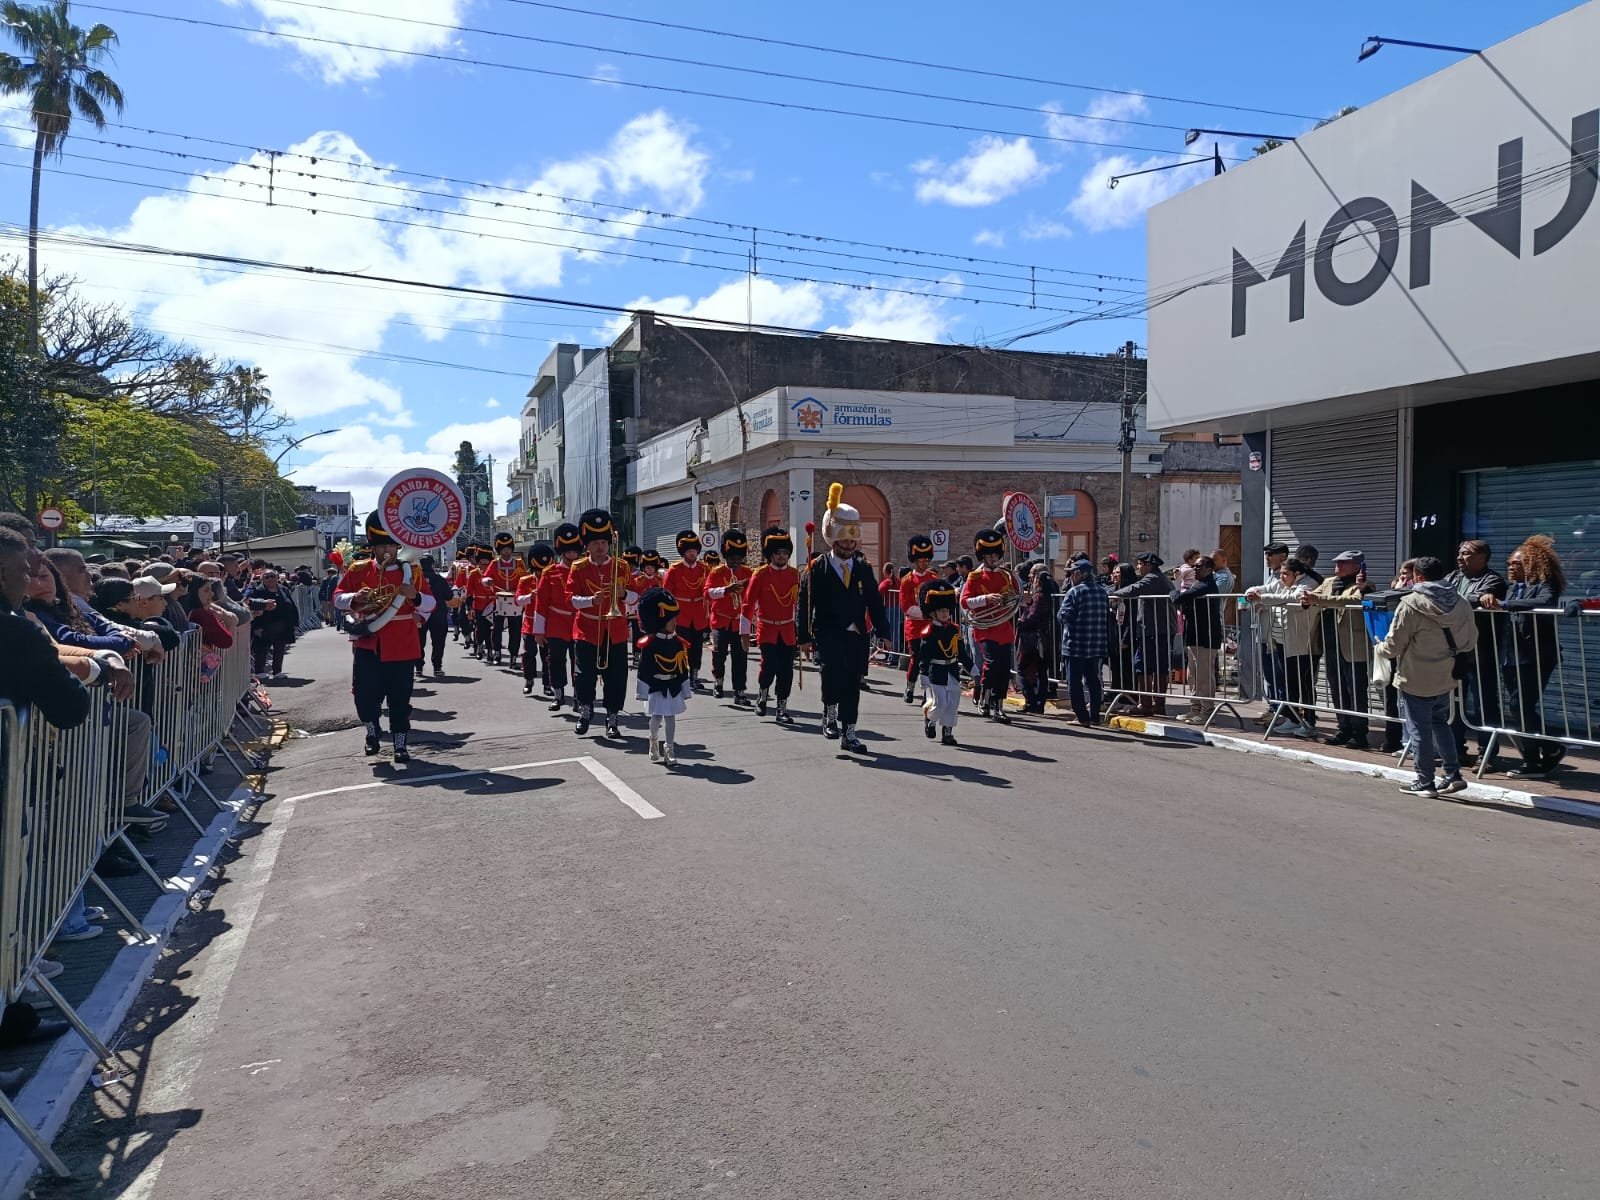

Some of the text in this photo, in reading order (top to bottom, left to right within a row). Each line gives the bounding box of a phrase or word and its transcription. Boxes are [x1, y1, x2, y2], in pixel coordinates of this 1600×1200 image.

[1231, 107, 1600, 339] MONJ
[833, 412, 892, 427] fórmulas
[834, 404, 877, 413] armazém
[394, 480, 460, 523] BANDA MARCIAL
[387, 507, 448, 546] SANTANENSE
[705, 536, 712, 544] E
